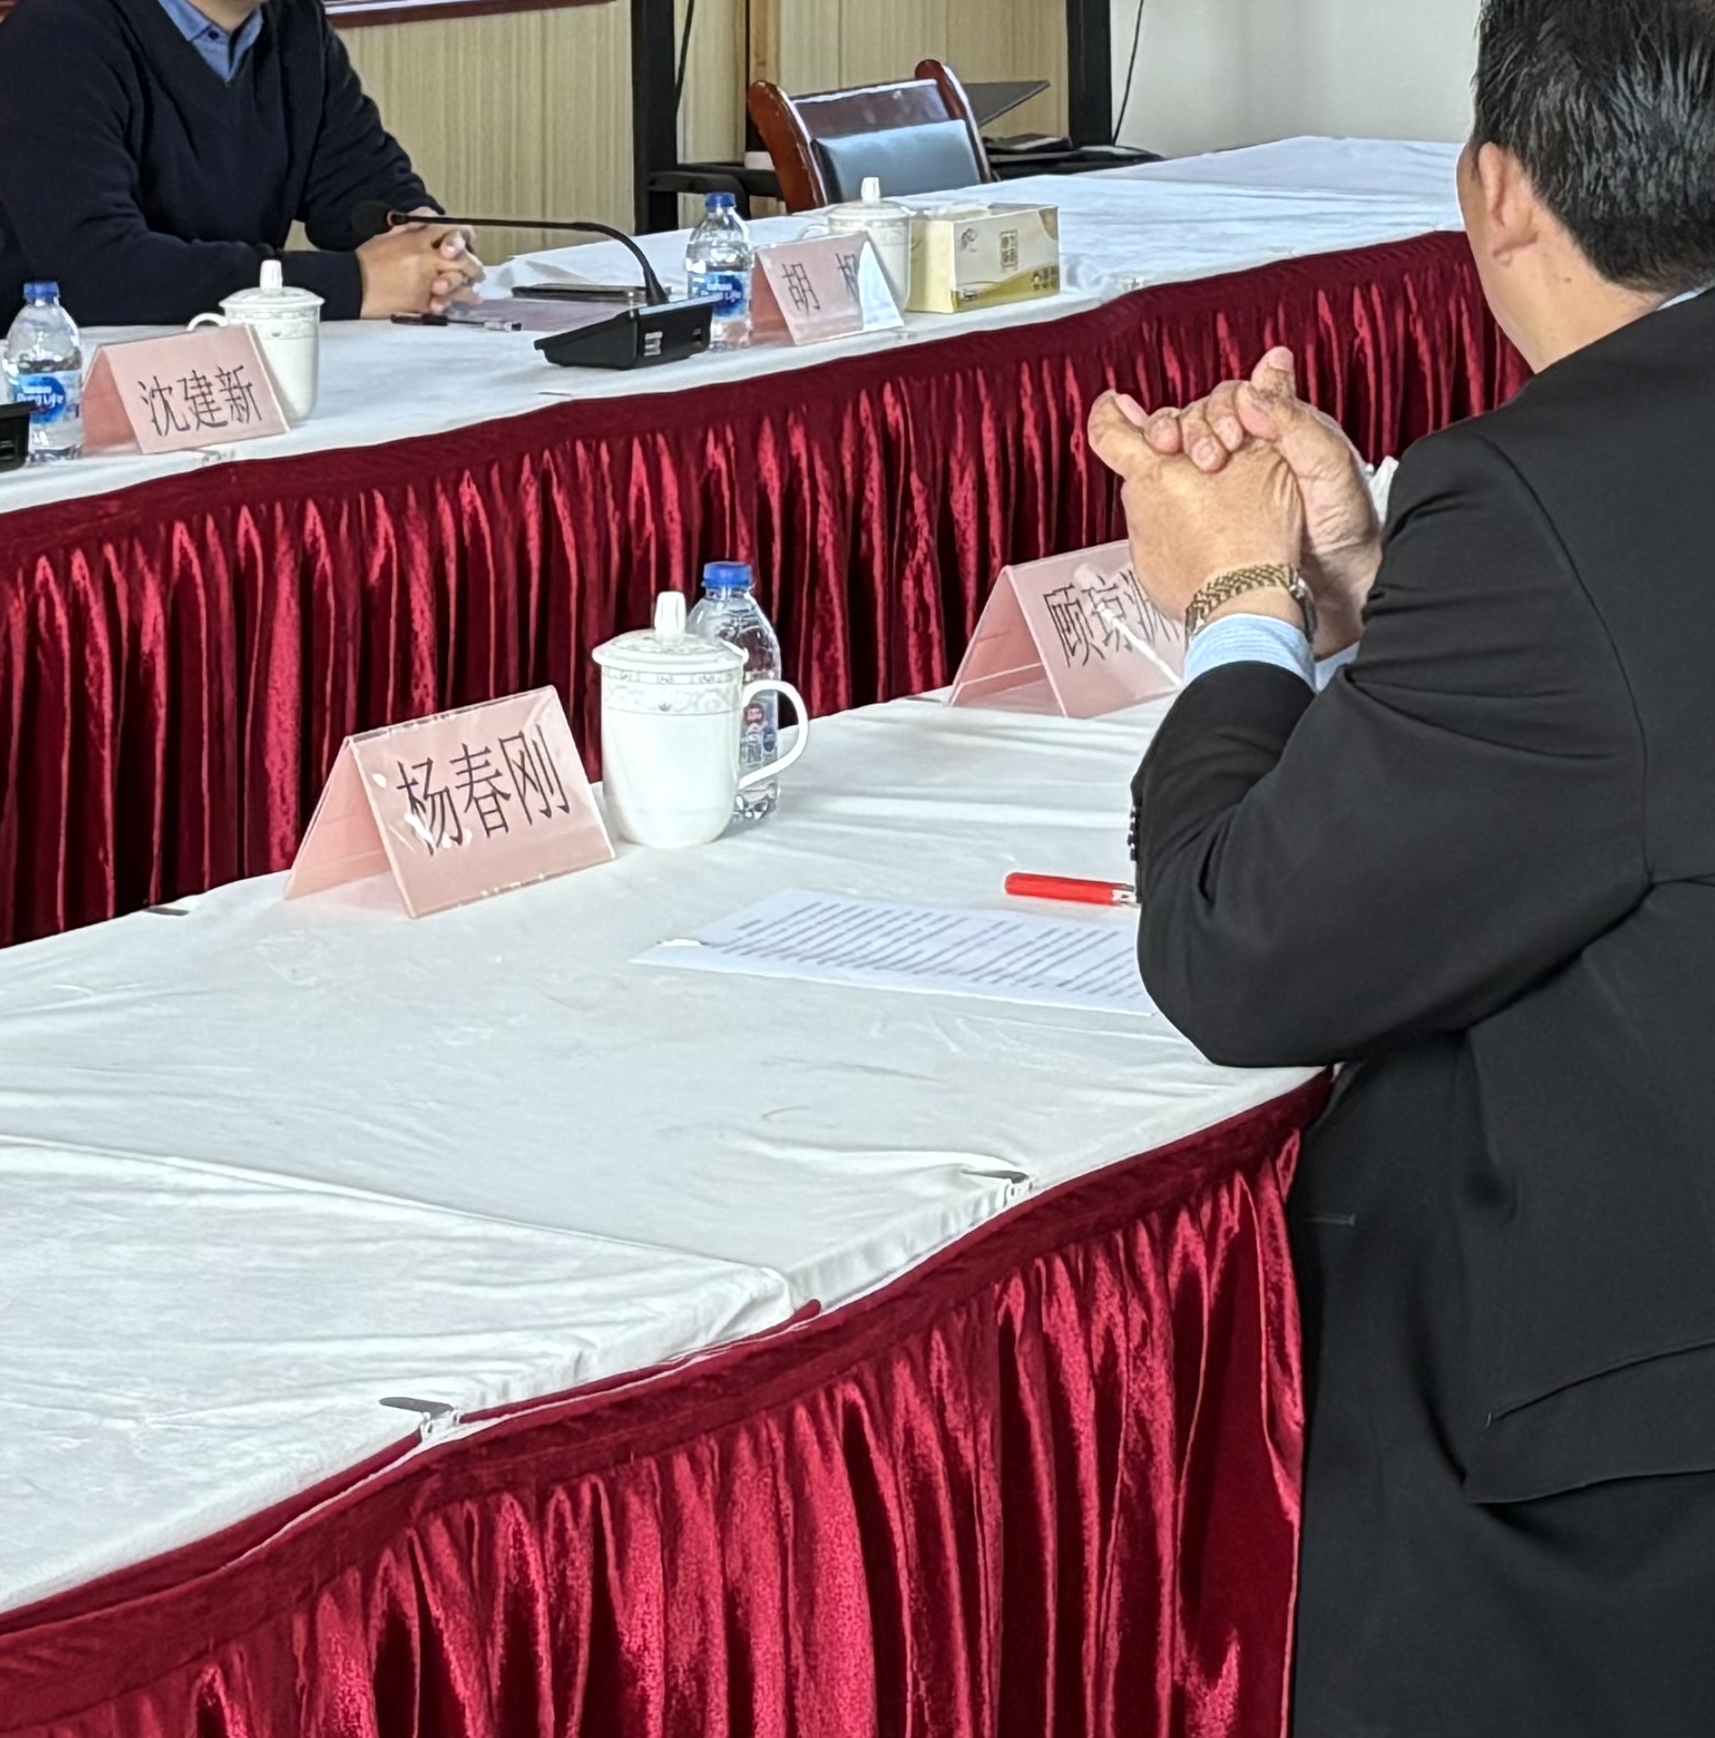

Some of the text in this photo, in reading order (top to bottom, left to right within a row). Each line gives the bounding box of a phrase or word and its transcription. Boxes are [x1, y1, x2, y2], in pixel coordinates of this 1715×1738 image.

[137, 365, 263, 437] 沈建新
[396, 724, 571, 857] 杨春刚
